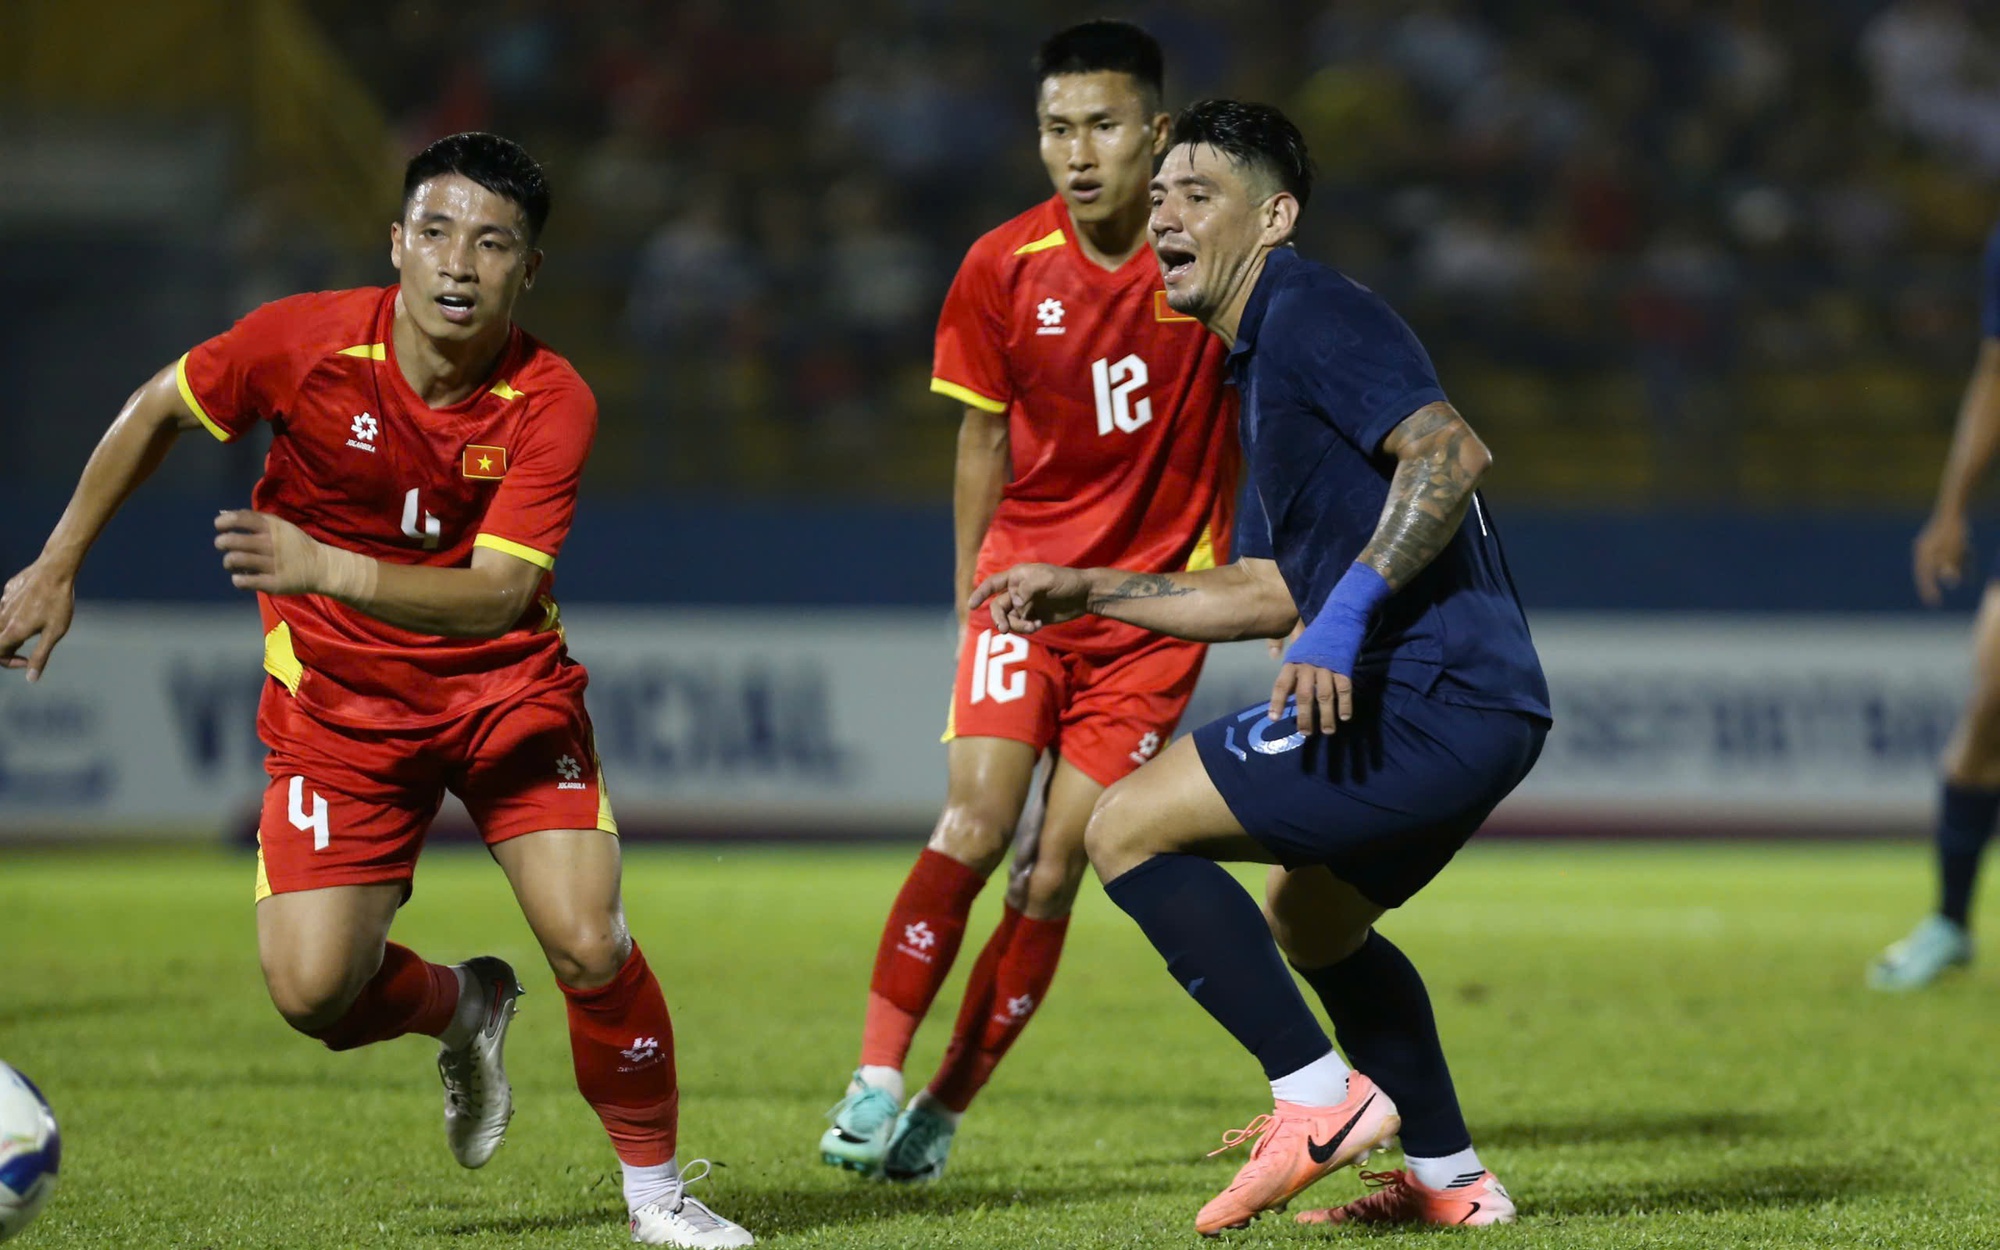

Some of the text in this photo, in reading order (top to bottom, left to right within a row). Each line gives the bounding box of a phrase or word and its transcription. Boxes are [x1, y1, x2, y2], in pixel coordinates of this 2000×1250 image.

[1092, 353, 1153, 437] 12
[401, 487, 441, 549] 4
[970, 628, 1030, 705] 12
[288, 775, 330, 851] 4
